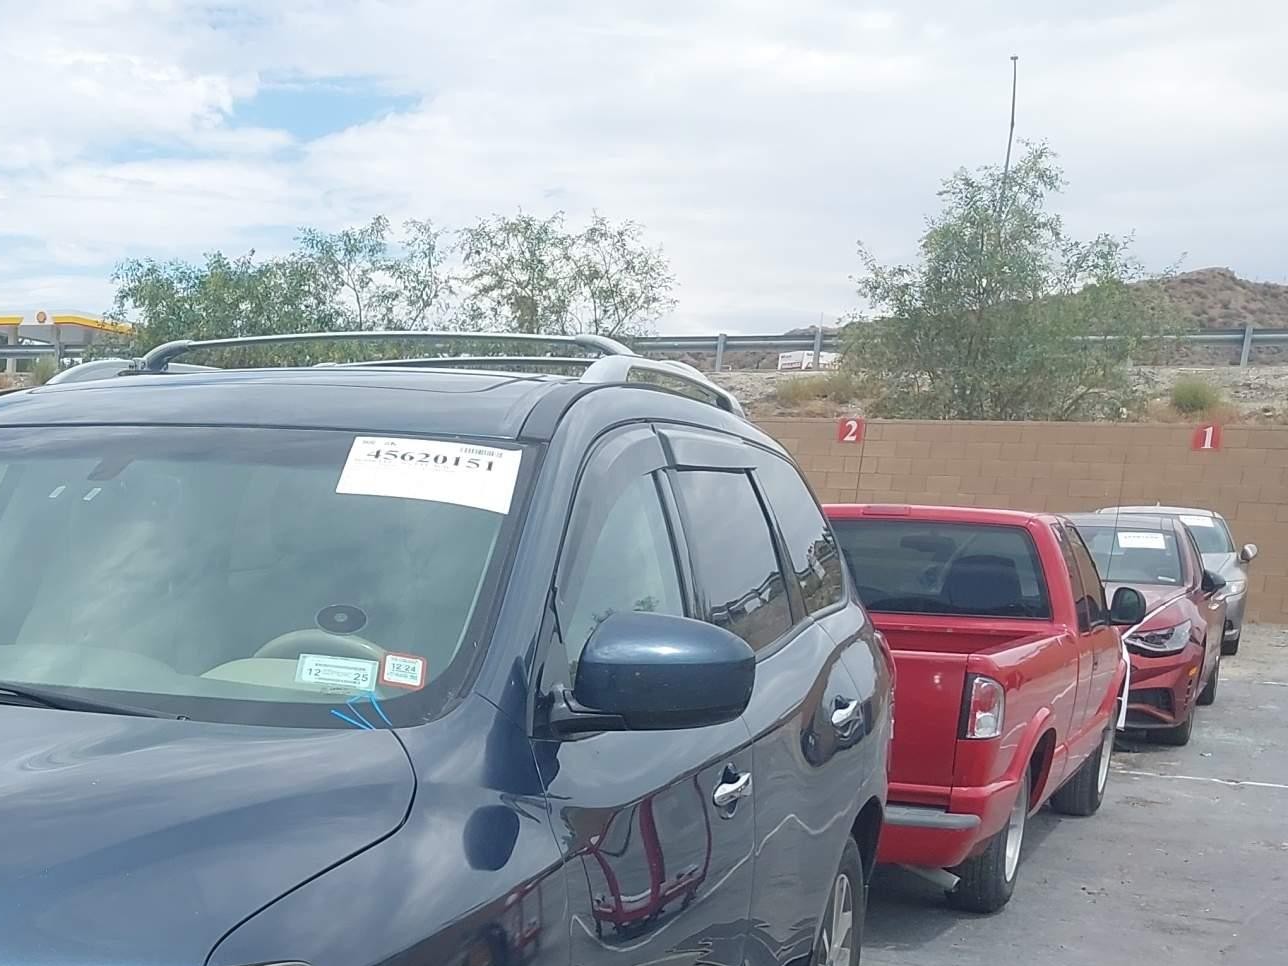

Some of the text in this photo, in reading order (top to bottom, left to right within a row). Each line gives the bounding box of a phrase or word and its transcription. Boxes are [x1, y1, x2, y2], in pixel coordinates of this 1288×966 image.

[843, 420, 858, 441] 2
[1200, 426, 1214, 449] 1
[366, 449, 494, 472] 45620151
[308, 668, 321, 677] 12
[353, 673, 368, 682] 25
